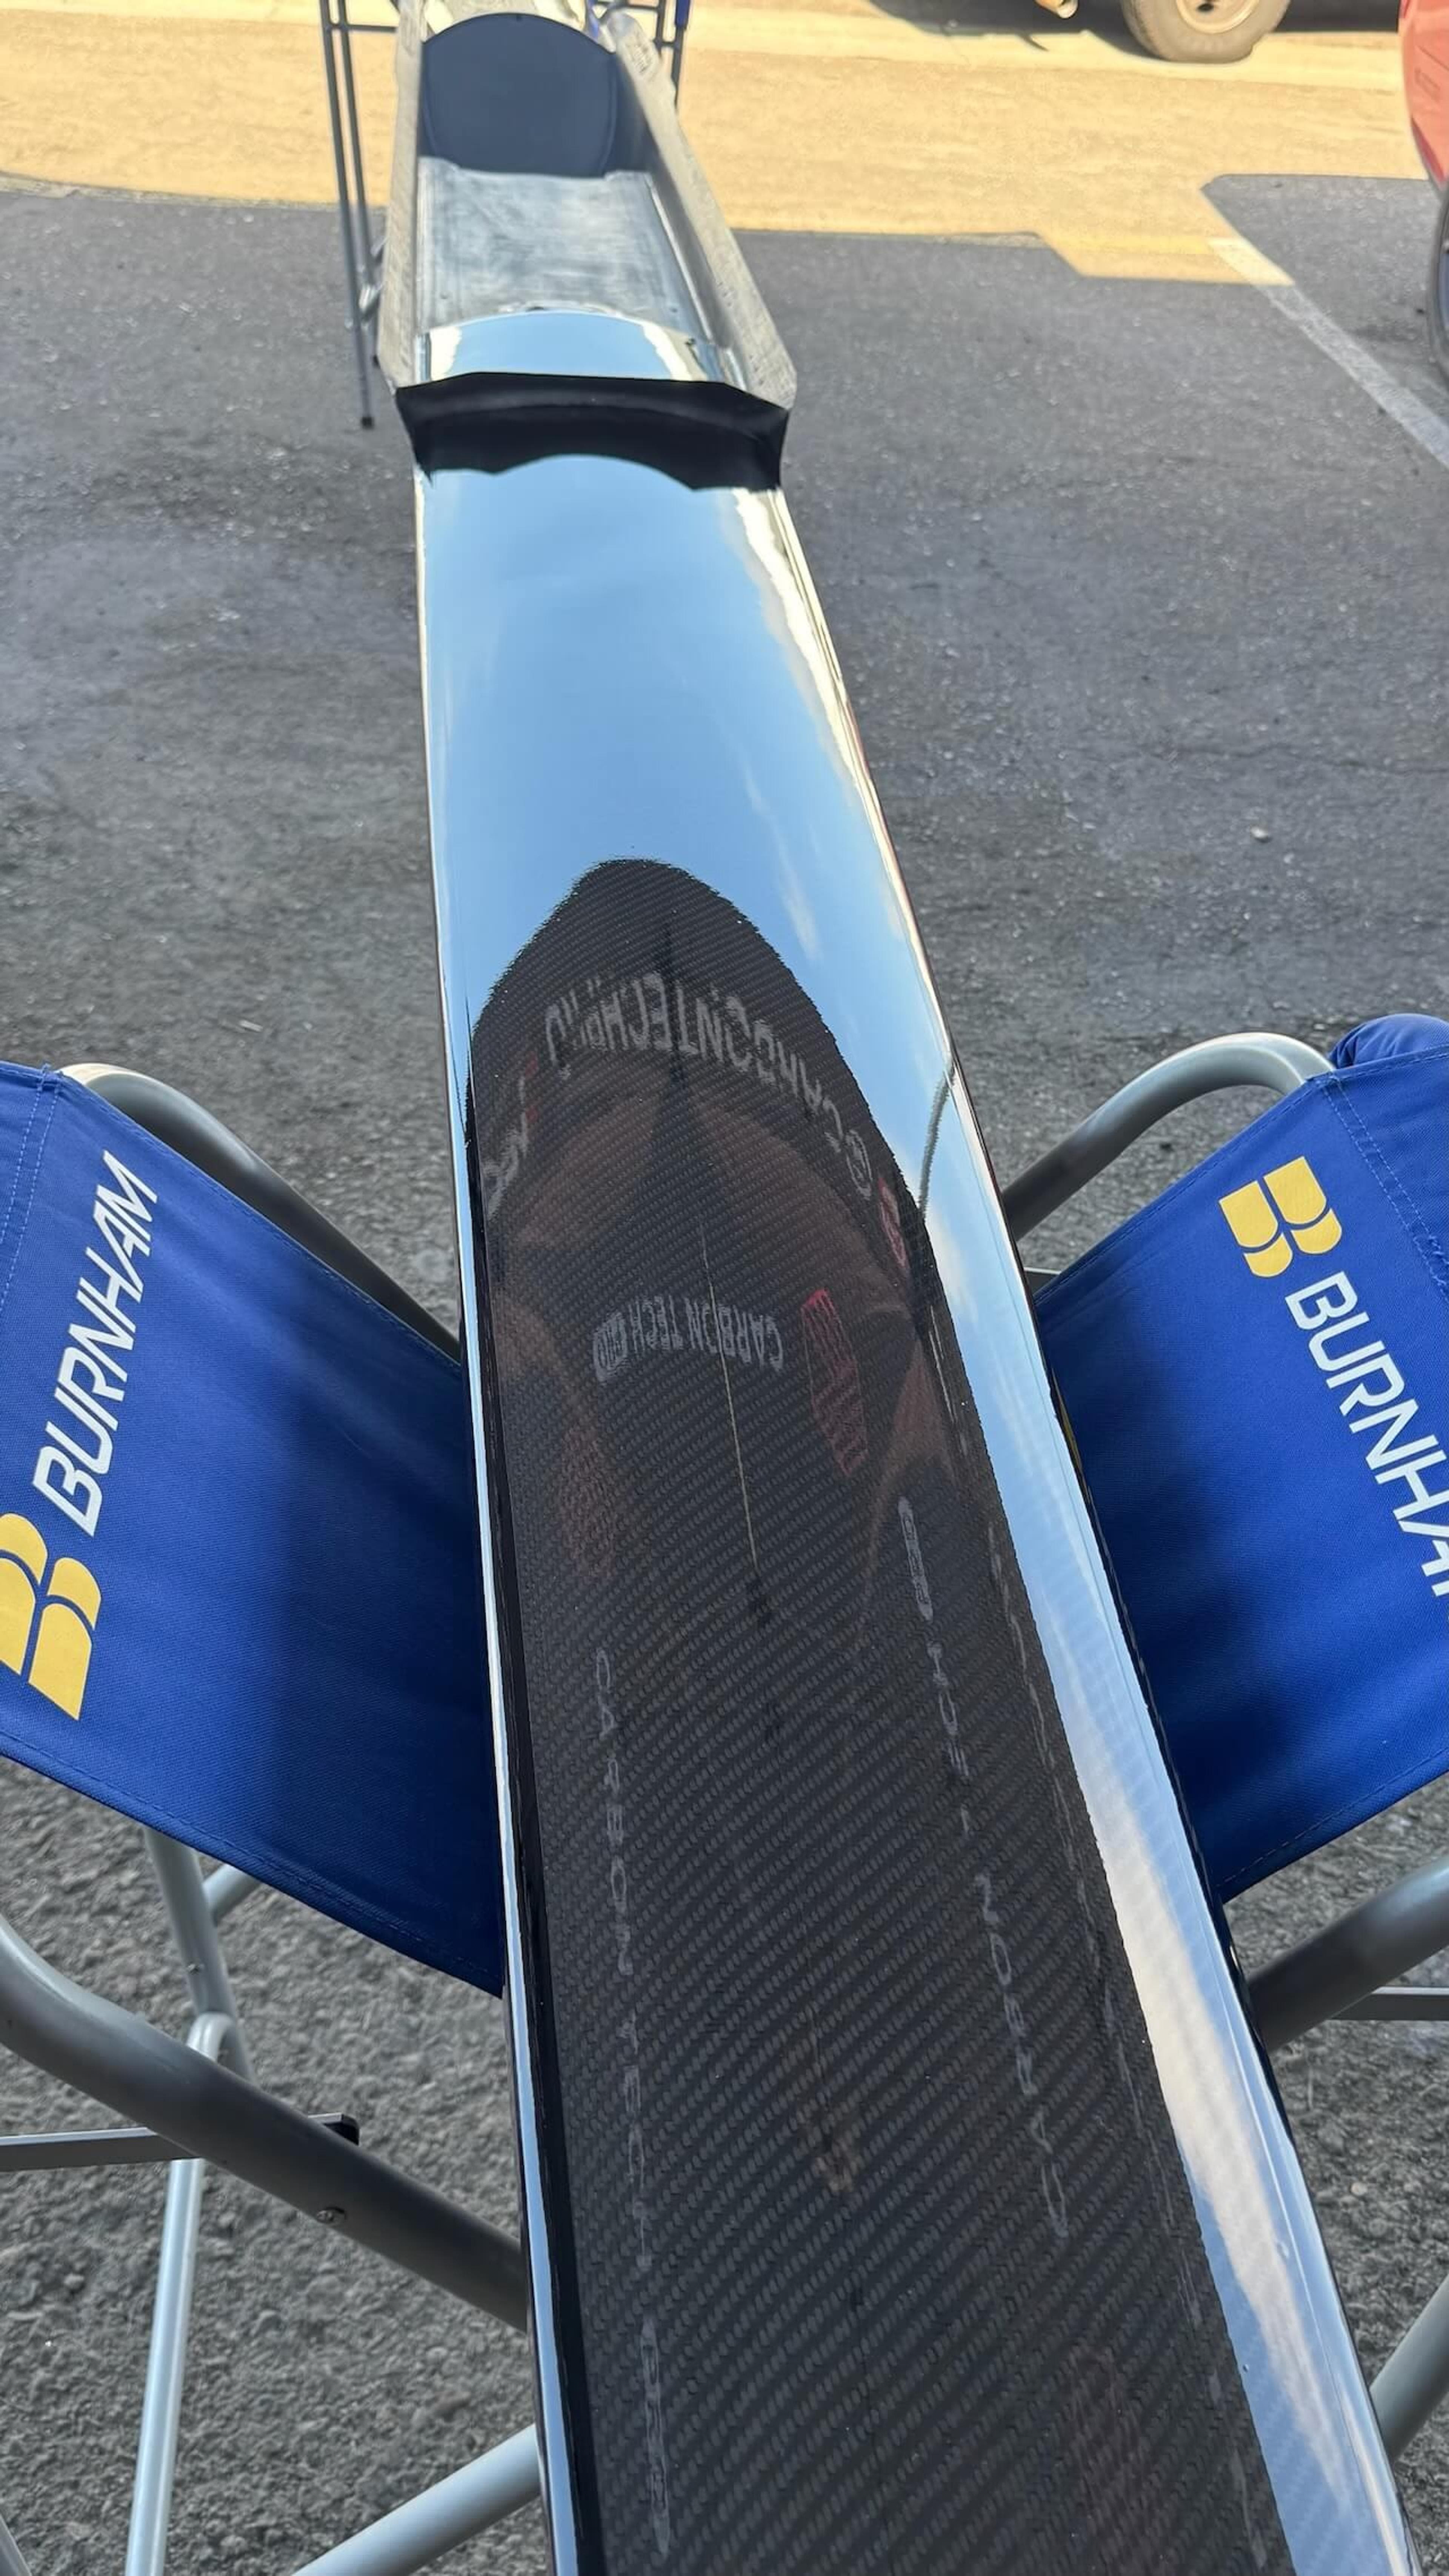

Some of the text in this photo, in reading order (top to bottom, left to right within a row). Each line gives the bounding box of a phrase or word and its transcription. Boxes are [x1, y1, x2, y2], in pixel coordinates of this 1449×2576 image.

[32, 1150, 158, 1536] BURNHAM
[685, 1298, 783, 1372] CARBON
[1285, 1271, 1449, 1598] BURNHA
